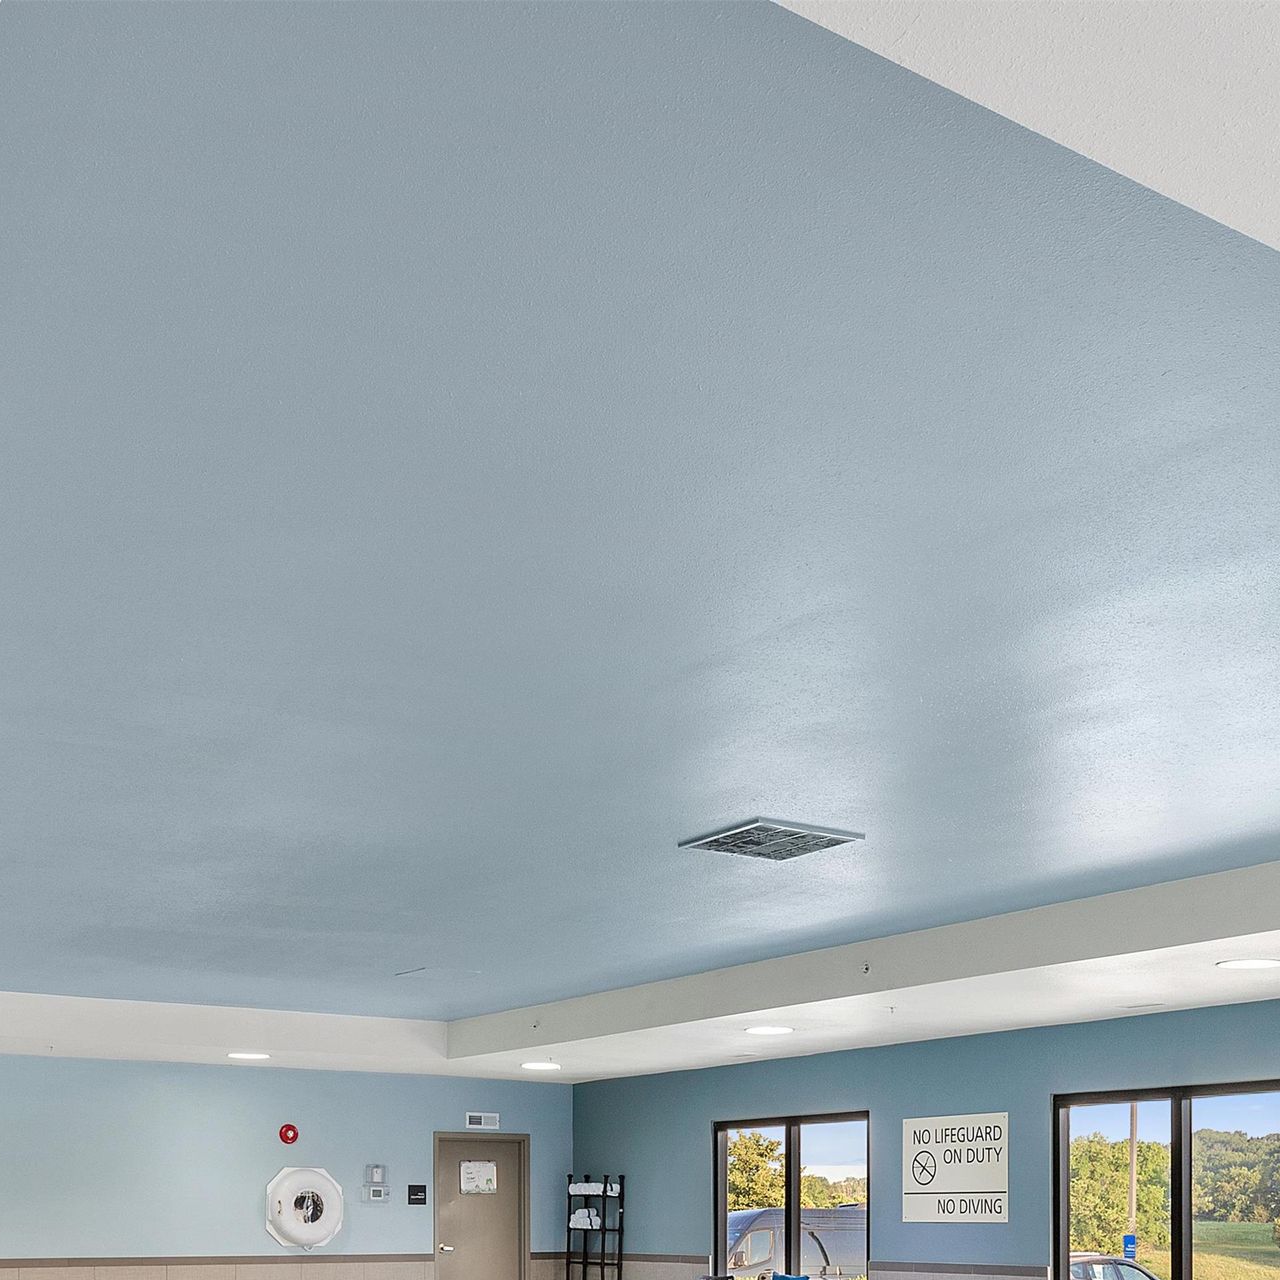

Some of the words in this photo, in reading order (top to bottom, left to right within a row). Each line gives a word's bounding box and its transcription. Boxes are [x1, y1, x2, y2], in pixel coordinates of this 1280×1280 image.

[913, 1129, 931, 1144] NO
[935, 1125, 1002, 1143] LIFEGUARD
[943, 1148, 962, 1164] ON
[966, 1147, 1002, 1163] DUTY
[937, 1199, 956, 1214] NO
[959, 1198, 1003, 1214] DIVING
